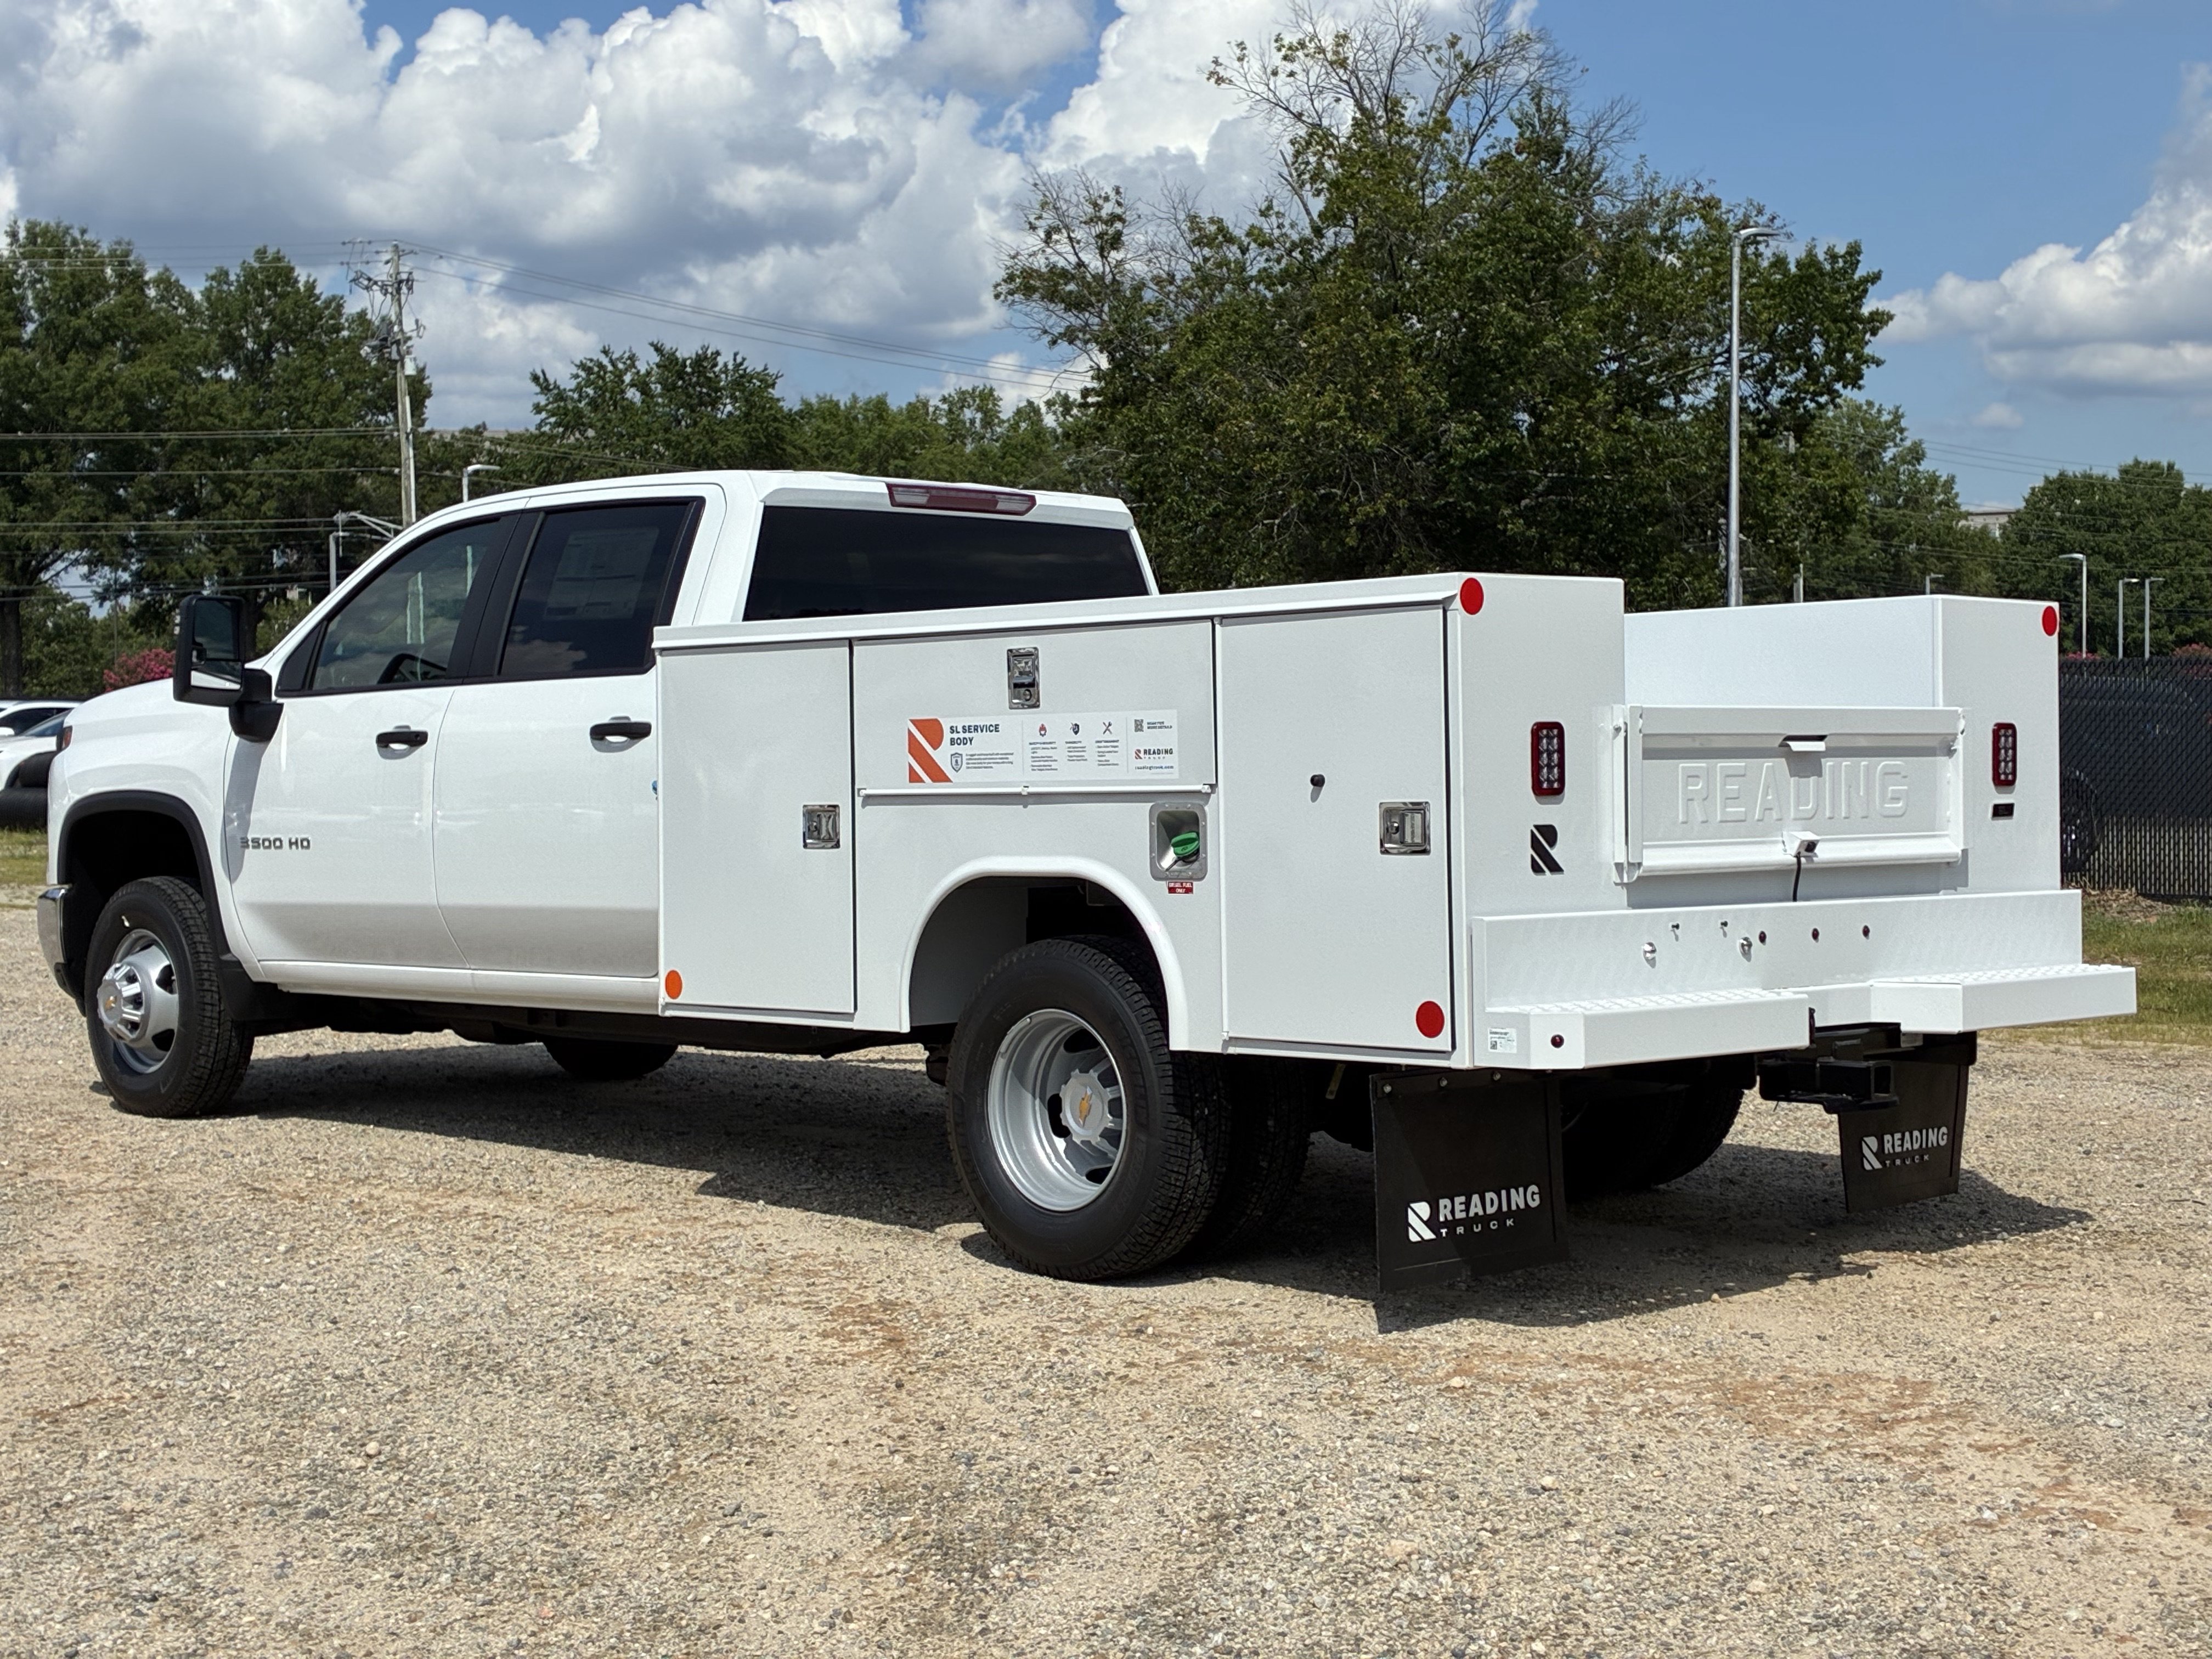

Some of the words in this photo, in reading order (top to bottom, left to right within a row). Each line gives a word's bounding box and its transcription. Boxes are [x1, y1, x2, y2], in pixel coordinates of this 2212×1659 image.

[950, 725, 961, 735] SL
[962, 724, 1000, 734] SERVICE
[950, 737, 974, 746] BODY
[1678, 761, 1908, 823] READING
[240, 837, 283, 850] 3500
[289, 837, 311, 850] HD
[1883, 1126, 1948, 1154] READING
[1885, 1154, 1929, 1167] TRUCK
[1439, 1184, 1541, 1222] READING
[1440, 1218, 1514, 1237] TRUCK
